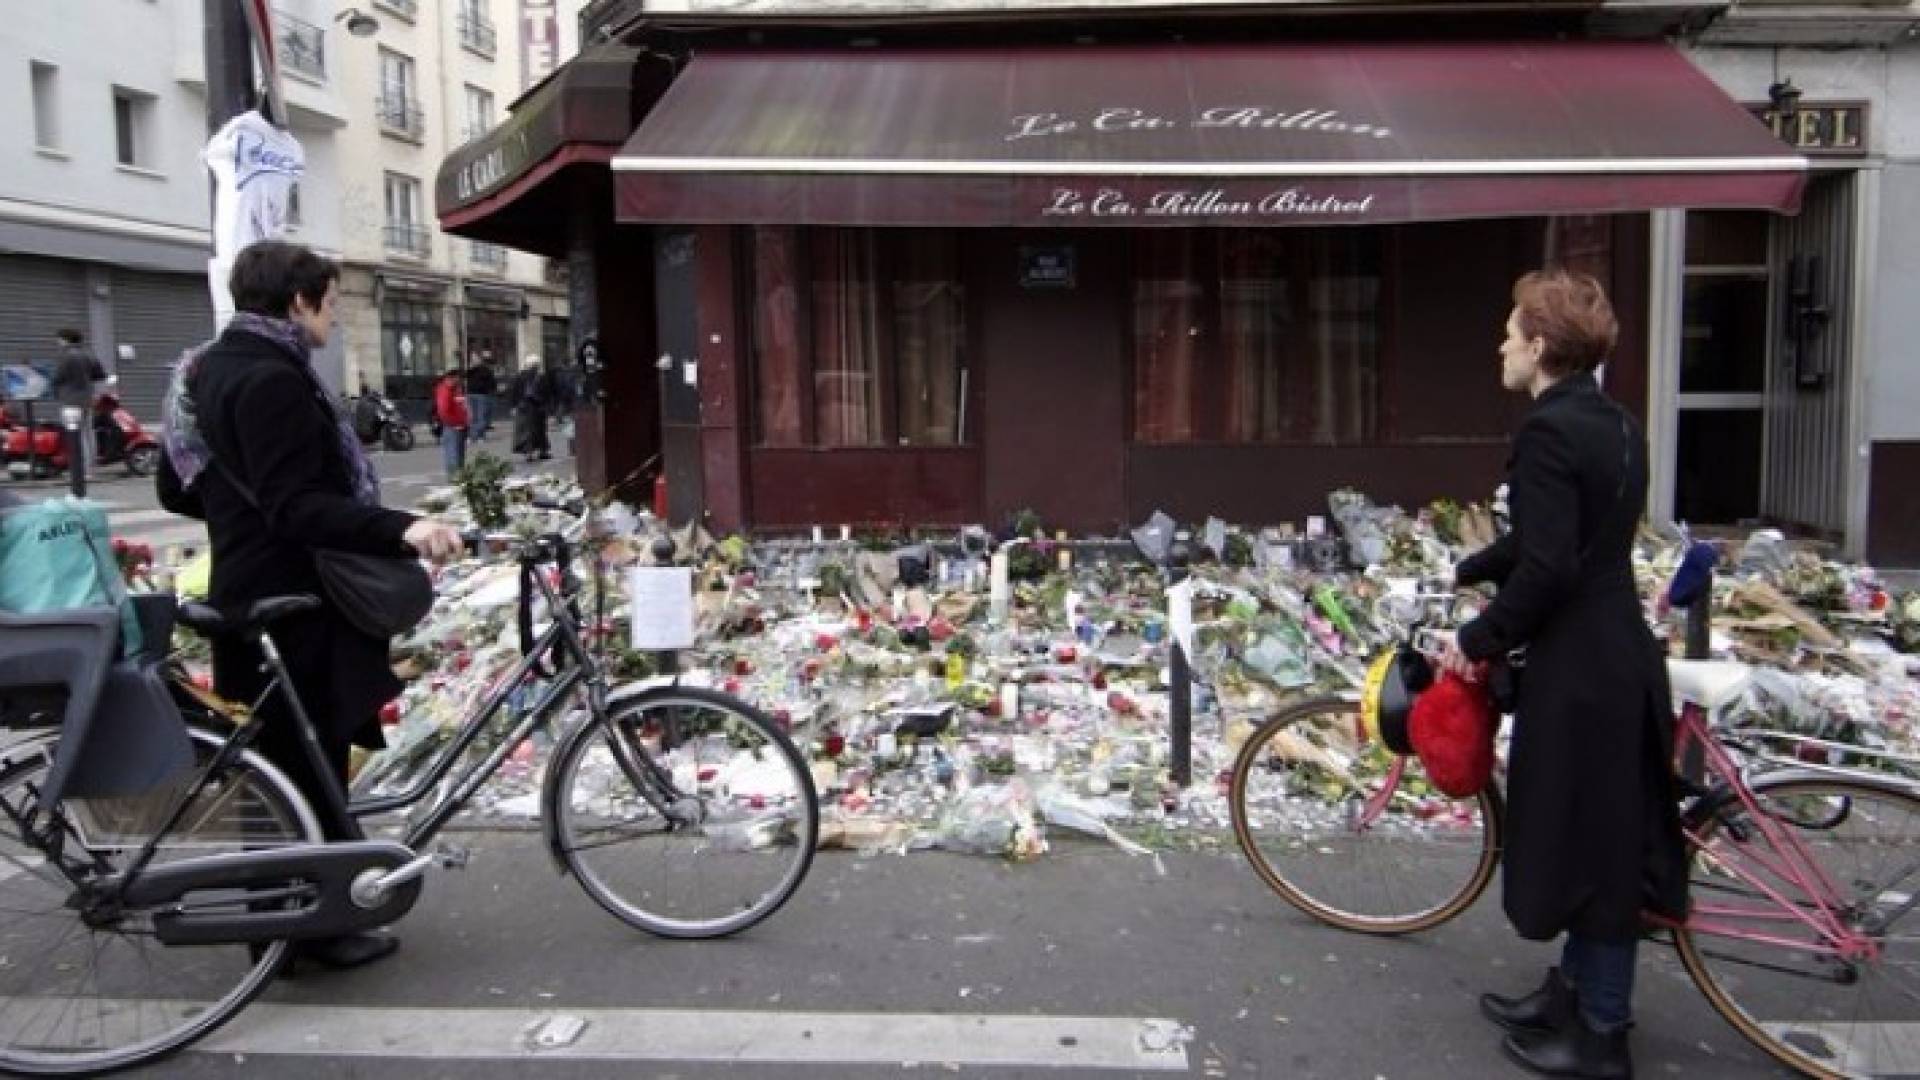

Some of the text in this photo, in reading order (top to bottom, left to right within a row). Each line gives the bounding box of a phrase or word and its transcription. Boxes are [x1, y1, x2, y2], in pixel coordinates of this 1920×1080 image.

[1004, 112, 1077, 142] Le
[1190, 107, 1391, 139] Rillon
[1042, 187, 1084, 216] Le
[1145, 188, 1249, 216] Rillon
[1258, 188, 1374, 215] Bistrot
